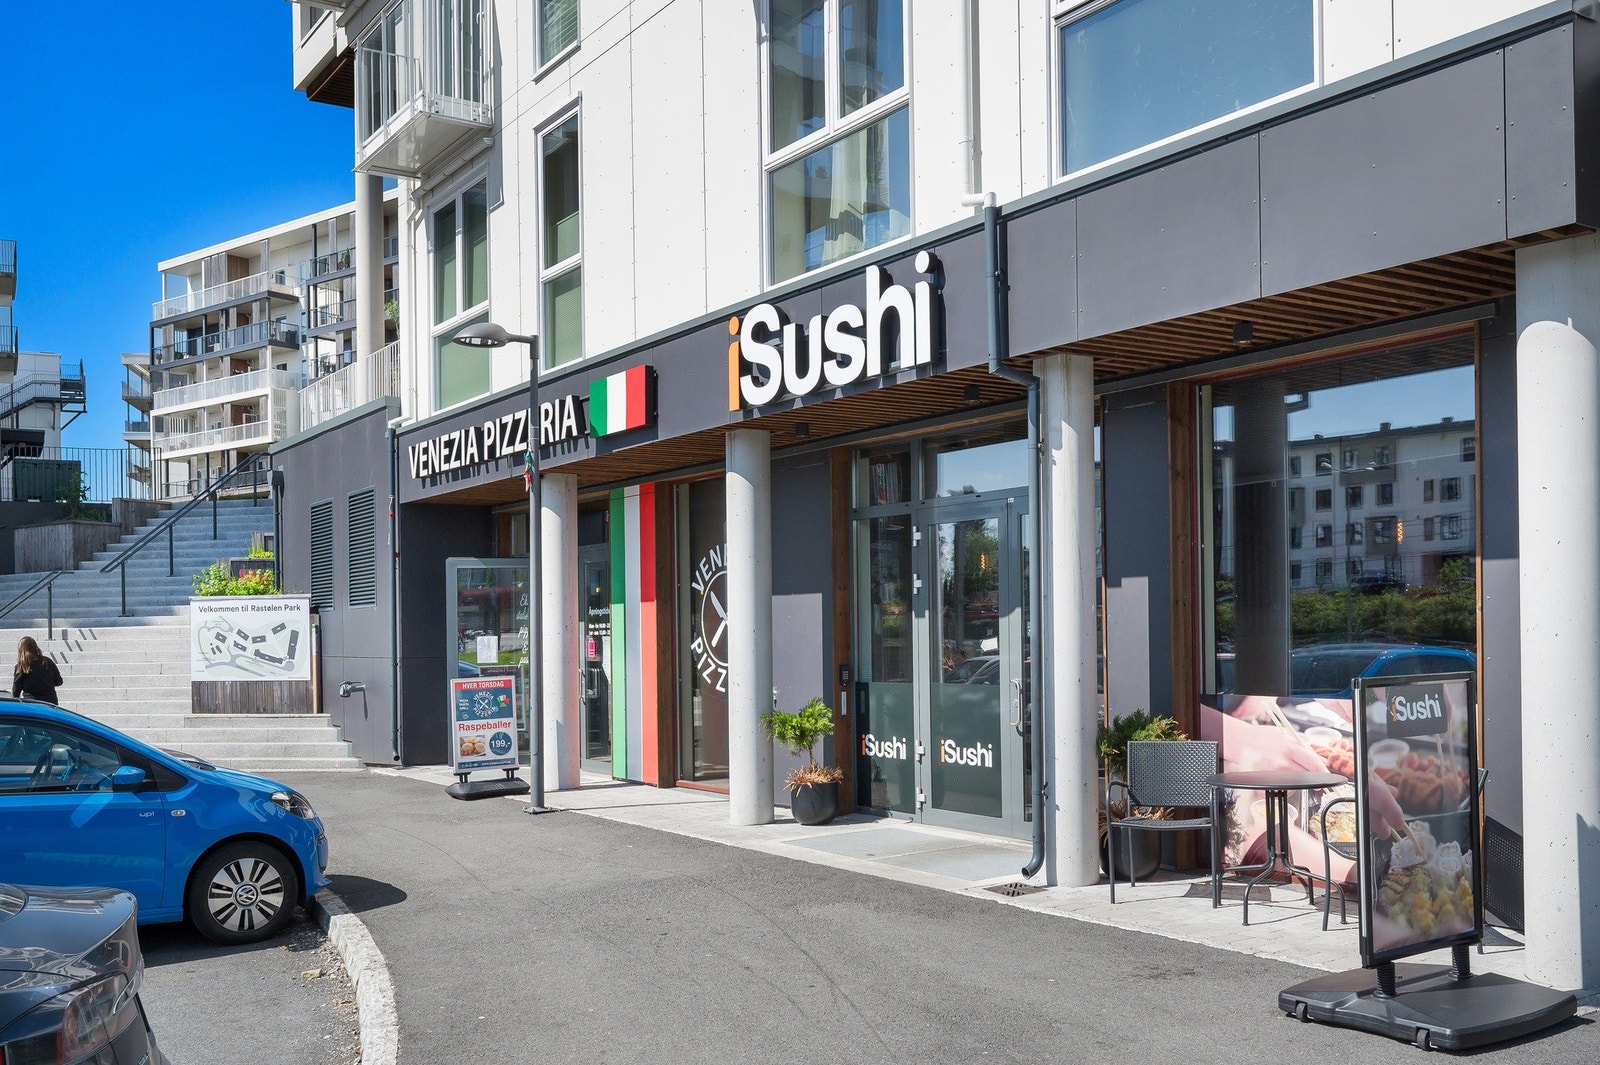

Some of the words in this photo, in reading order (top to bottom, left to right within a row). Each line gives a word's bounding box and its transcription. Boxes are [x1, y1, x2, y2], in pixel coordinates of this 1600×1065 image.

[728, 250, 931, 411] iSushi
[408, 426, 478, 479] VENEZIA
[198, 605, 240, 613] Velkommen
[241, 604, 249, 612] til
[283, 603, 301, 611] Park
[458, 721, 512, 732] Raspeballer
[861, 733, 907, 760] iSushi
[940, 738, 993, 768] iSushi
